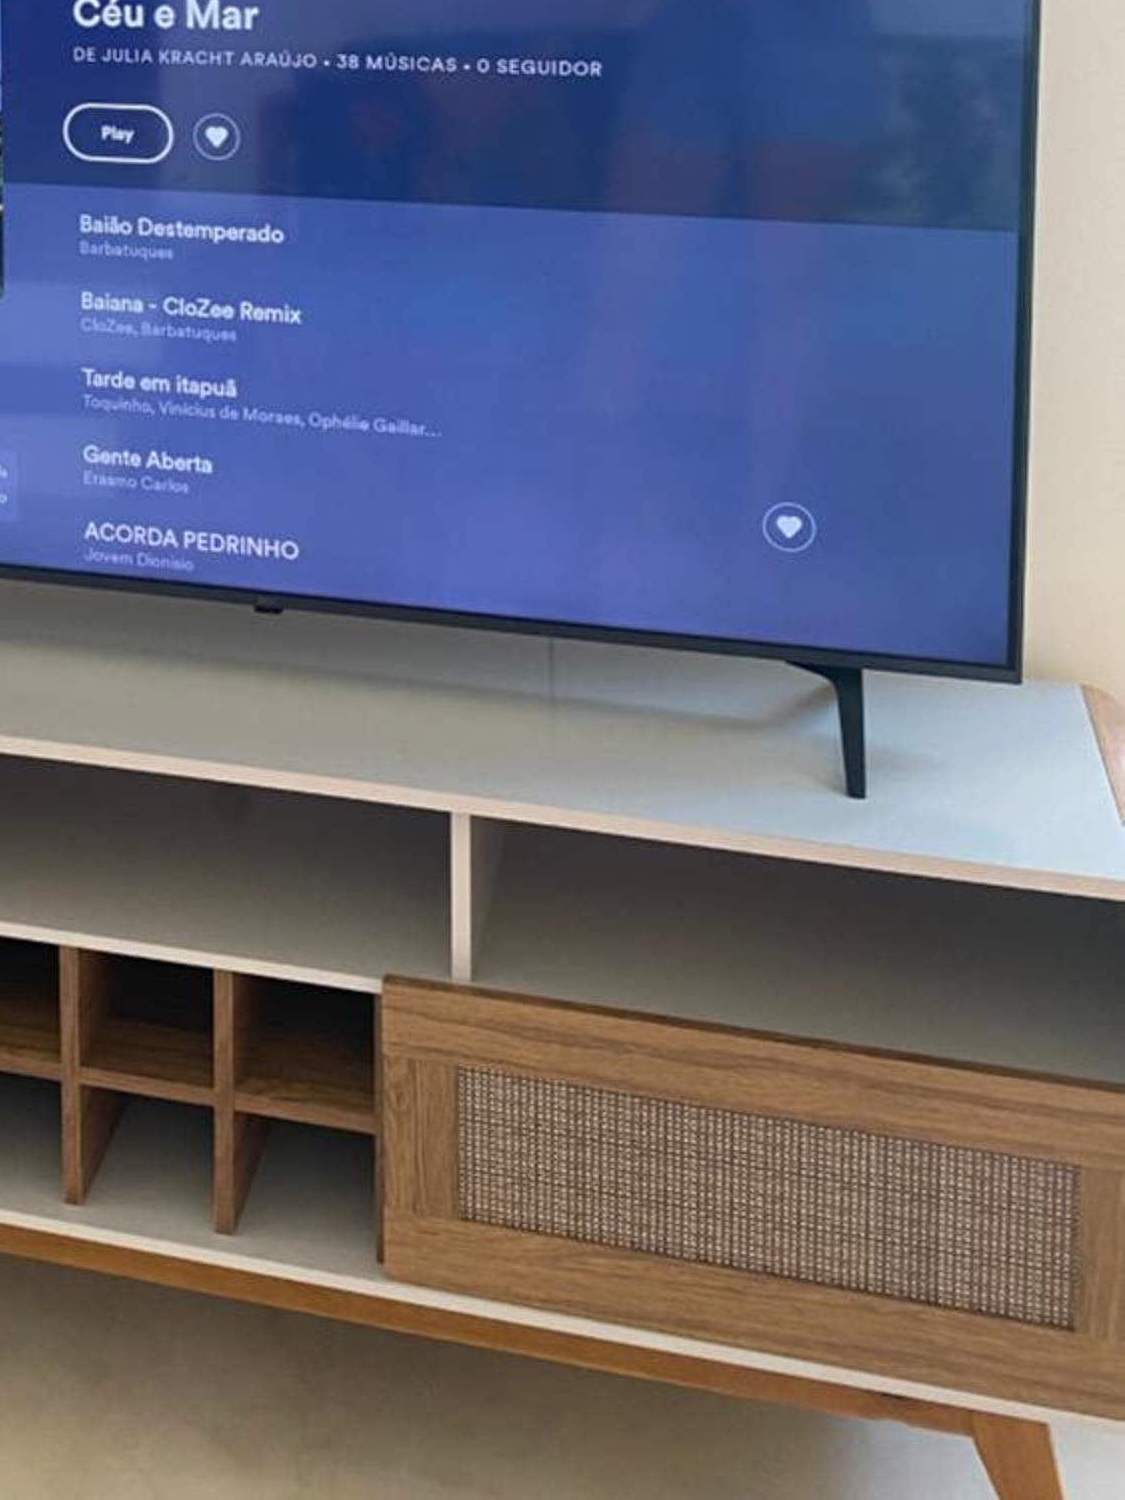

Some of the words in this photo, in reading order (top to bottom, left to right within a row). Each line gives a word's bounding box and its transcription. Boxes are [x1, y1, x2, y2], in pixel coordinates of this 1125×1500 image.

[154, 3, 175, 28] e
[73, 47, 96, 63] DE
[102, 47, 153, 65] JULIA
[159, 49, 236, 67] KRACHT
[241, 48, 317, 69] ARAÚJO
[336, 53, 359, 71] 38
[366, 52, 457, 73] MÚSICAS
[497, 57, 603, 78] SEGUIDOR
[101, 124, 135, 145] Play
[80, 214, 132, 237] Baião
[138, 218, 284, 245] Destemperado
[80, 241, 173, 261] Barbatuques
[81, 292, 144, 313] Baiana
[163, 296, 234, 320] CloZee
[241, 302, 302, 325] Remix
[81, 317, 139, 337] CloZee,
[141, 321, 237, 344] Barbatuques
[81, 368, 135, 391] Tarde
[140, 376, 170, 394] em
[84, 395, 155, 417] Toquinho,
[220, 403, 238, 420] de
[84, 445, 142, 468] Gente
[146, 450, 213, 474] Aberta
[84, 472, 137, 489] Erasmo
[141, 474, 190, 494] Carlos
[84, 521, 179, 548] ACORDA
[184, 531, 300, 561] PEDRINHO
[84, 548, 135, 567] Jovem
